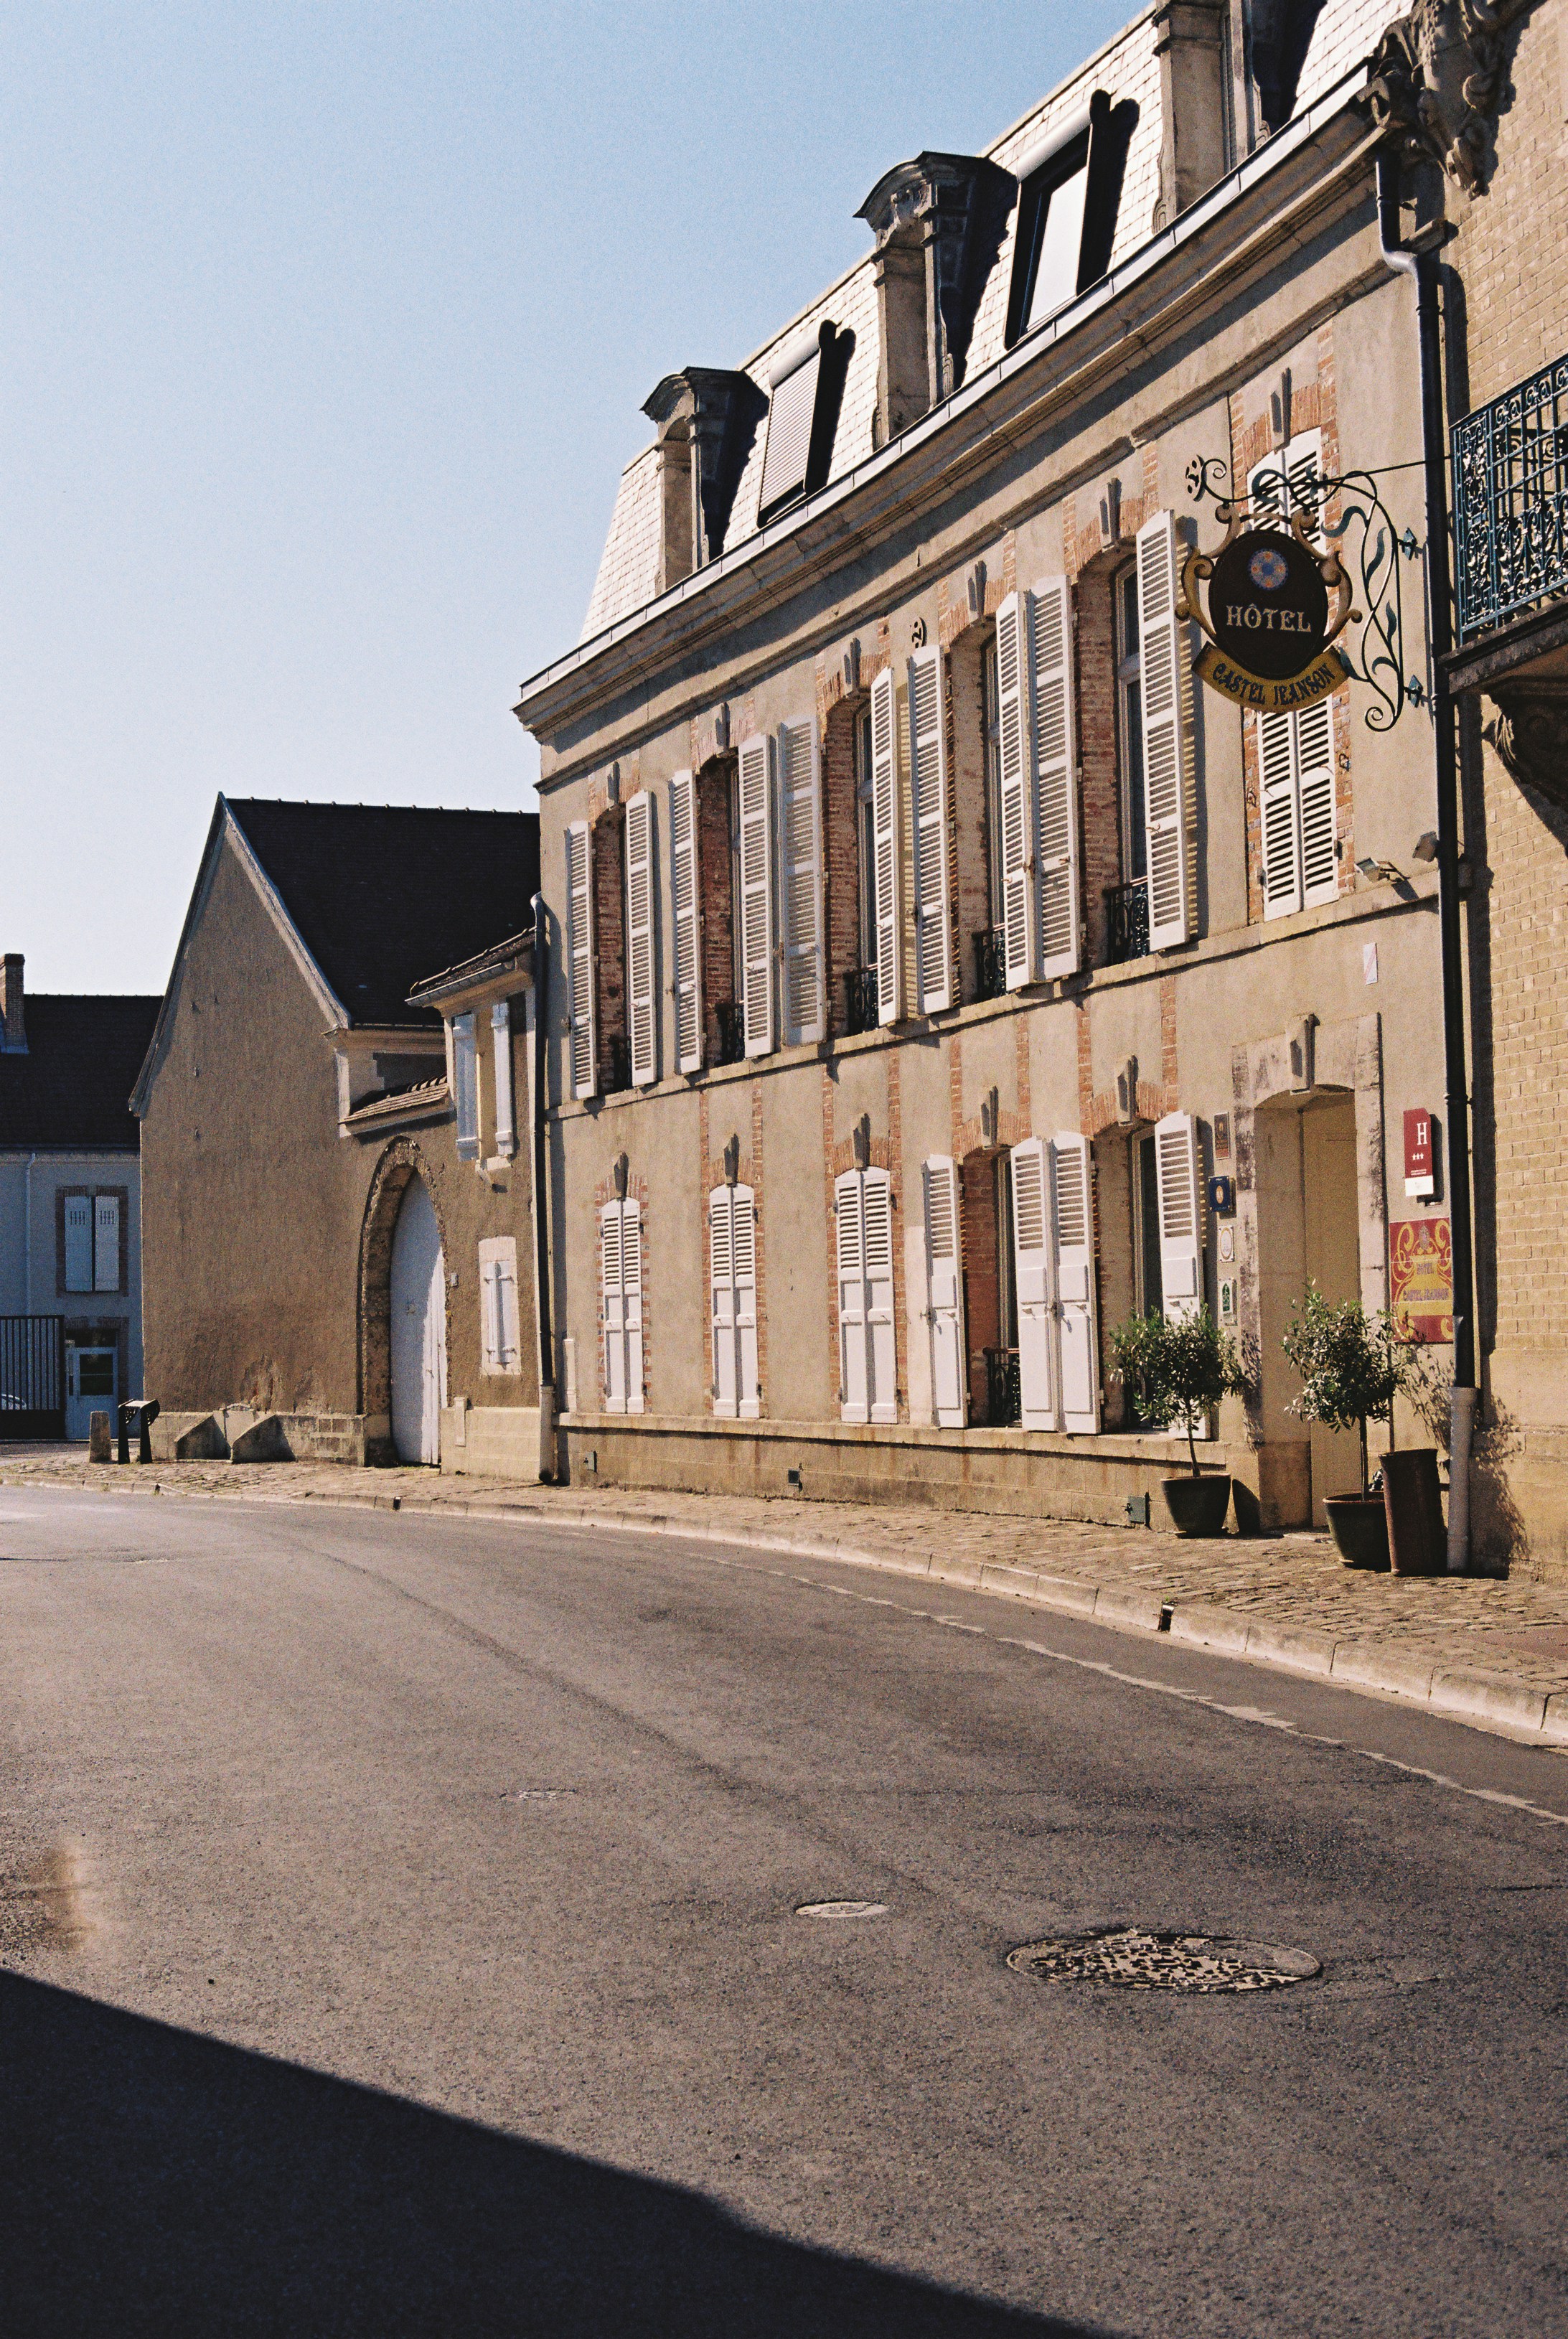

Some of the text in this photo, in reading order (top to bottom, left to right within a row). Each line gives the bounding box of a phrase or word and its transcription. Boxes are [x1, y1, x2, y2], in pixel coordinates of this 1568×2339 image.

[1226, 603, 1312, 632] HÔTEL
[1213, 663, 1335, 706] CASTEL JEANSON
[1417, 1122, 1428, 1145] H
